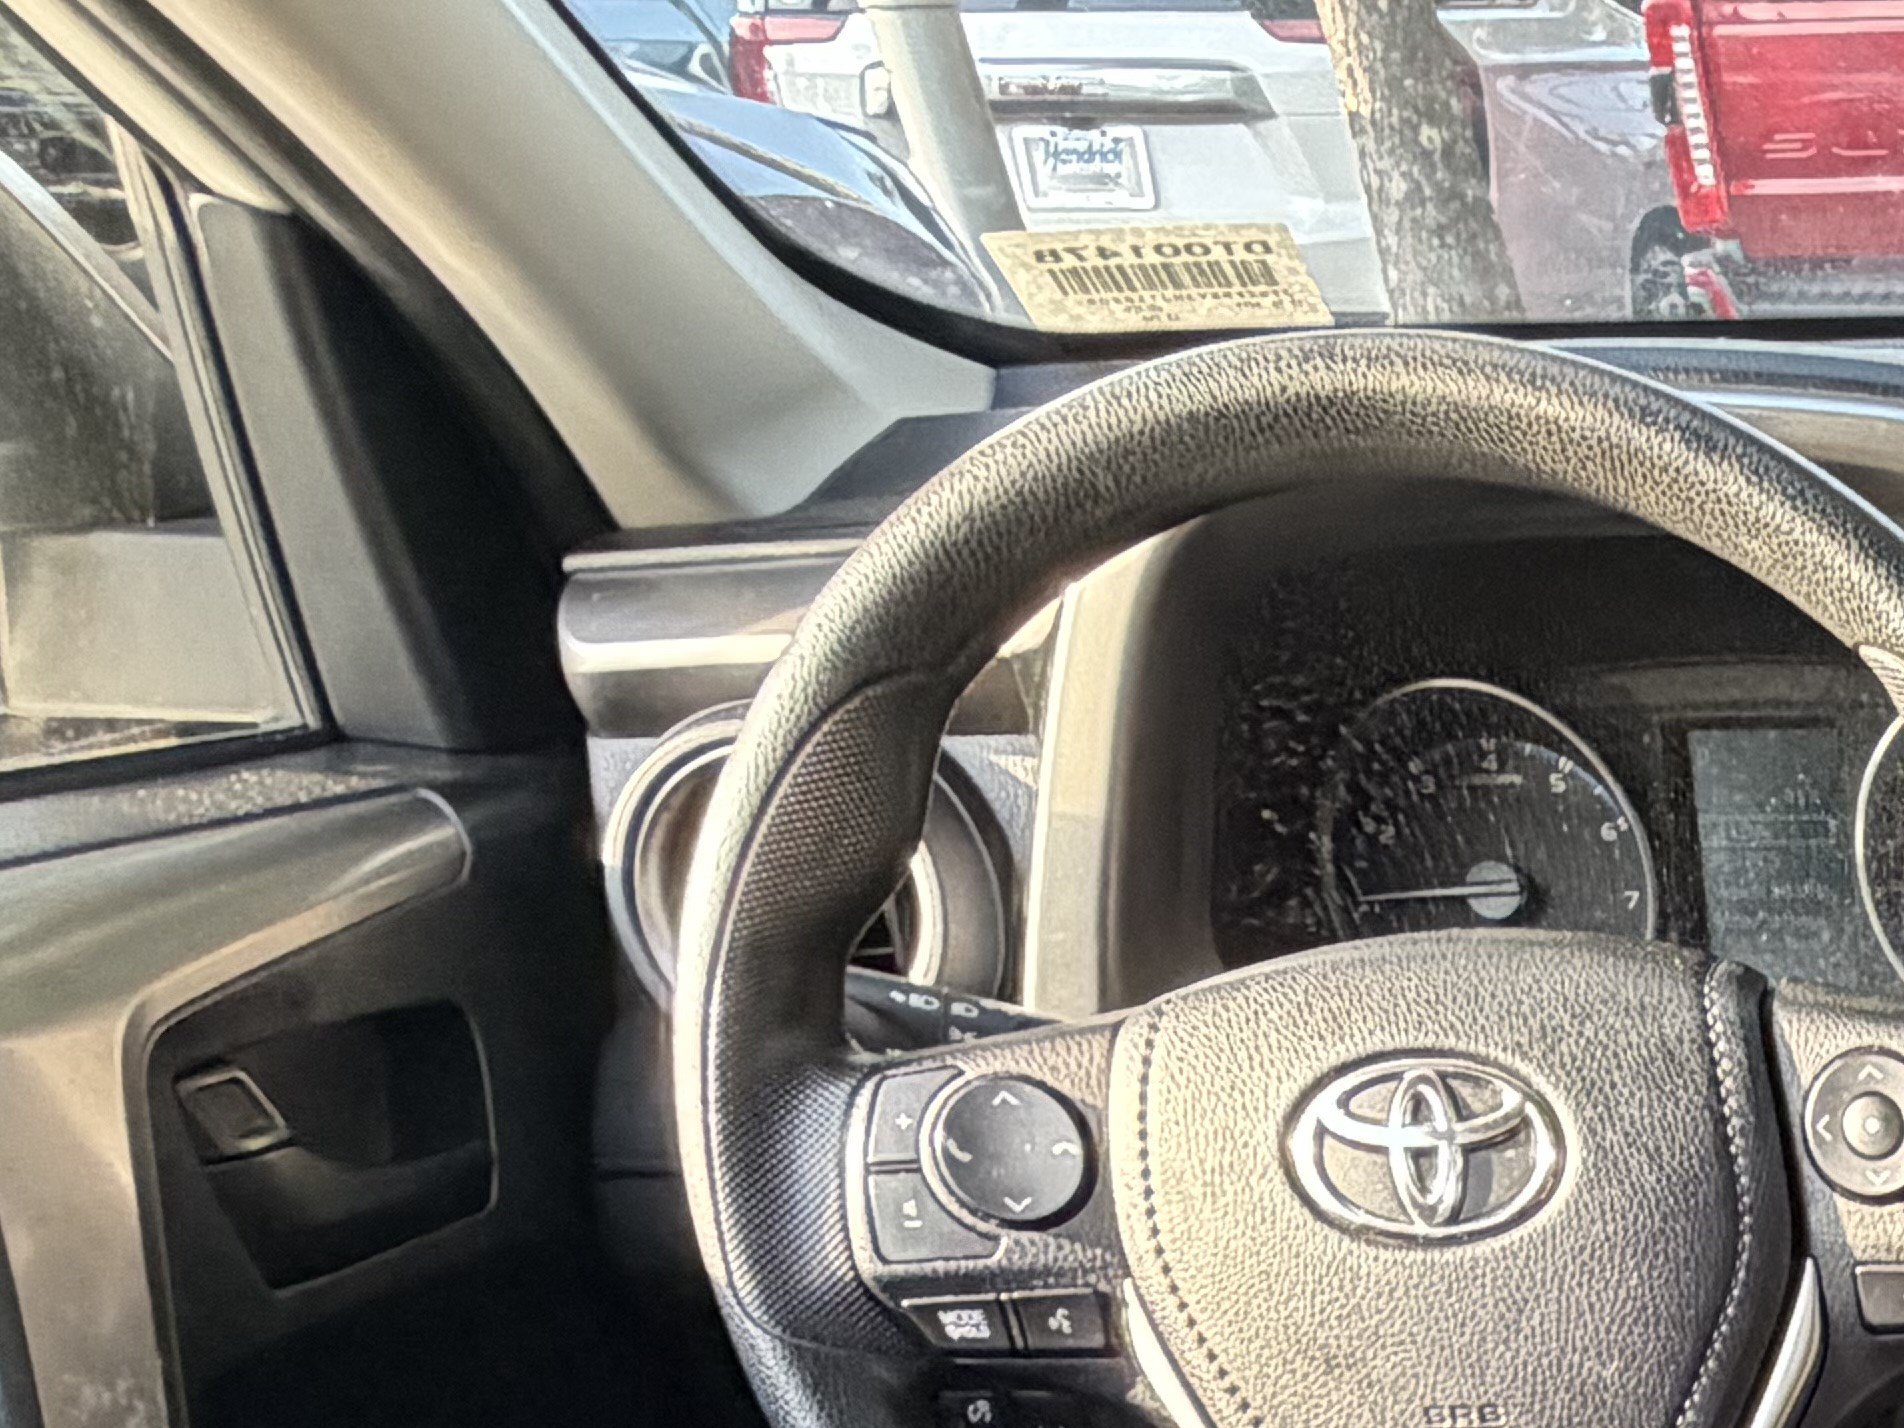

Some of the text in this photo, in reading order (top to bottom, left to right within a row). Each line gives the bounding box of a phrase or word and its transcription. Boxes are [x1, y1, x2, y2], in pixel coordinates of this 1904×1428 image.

[1550, 773, 1567, 794] 5
[1600, 822, 1618, 843] 6
[1624, 890, 1640, 910] 7
[1423, 1403, 1506, 1428] SRS
